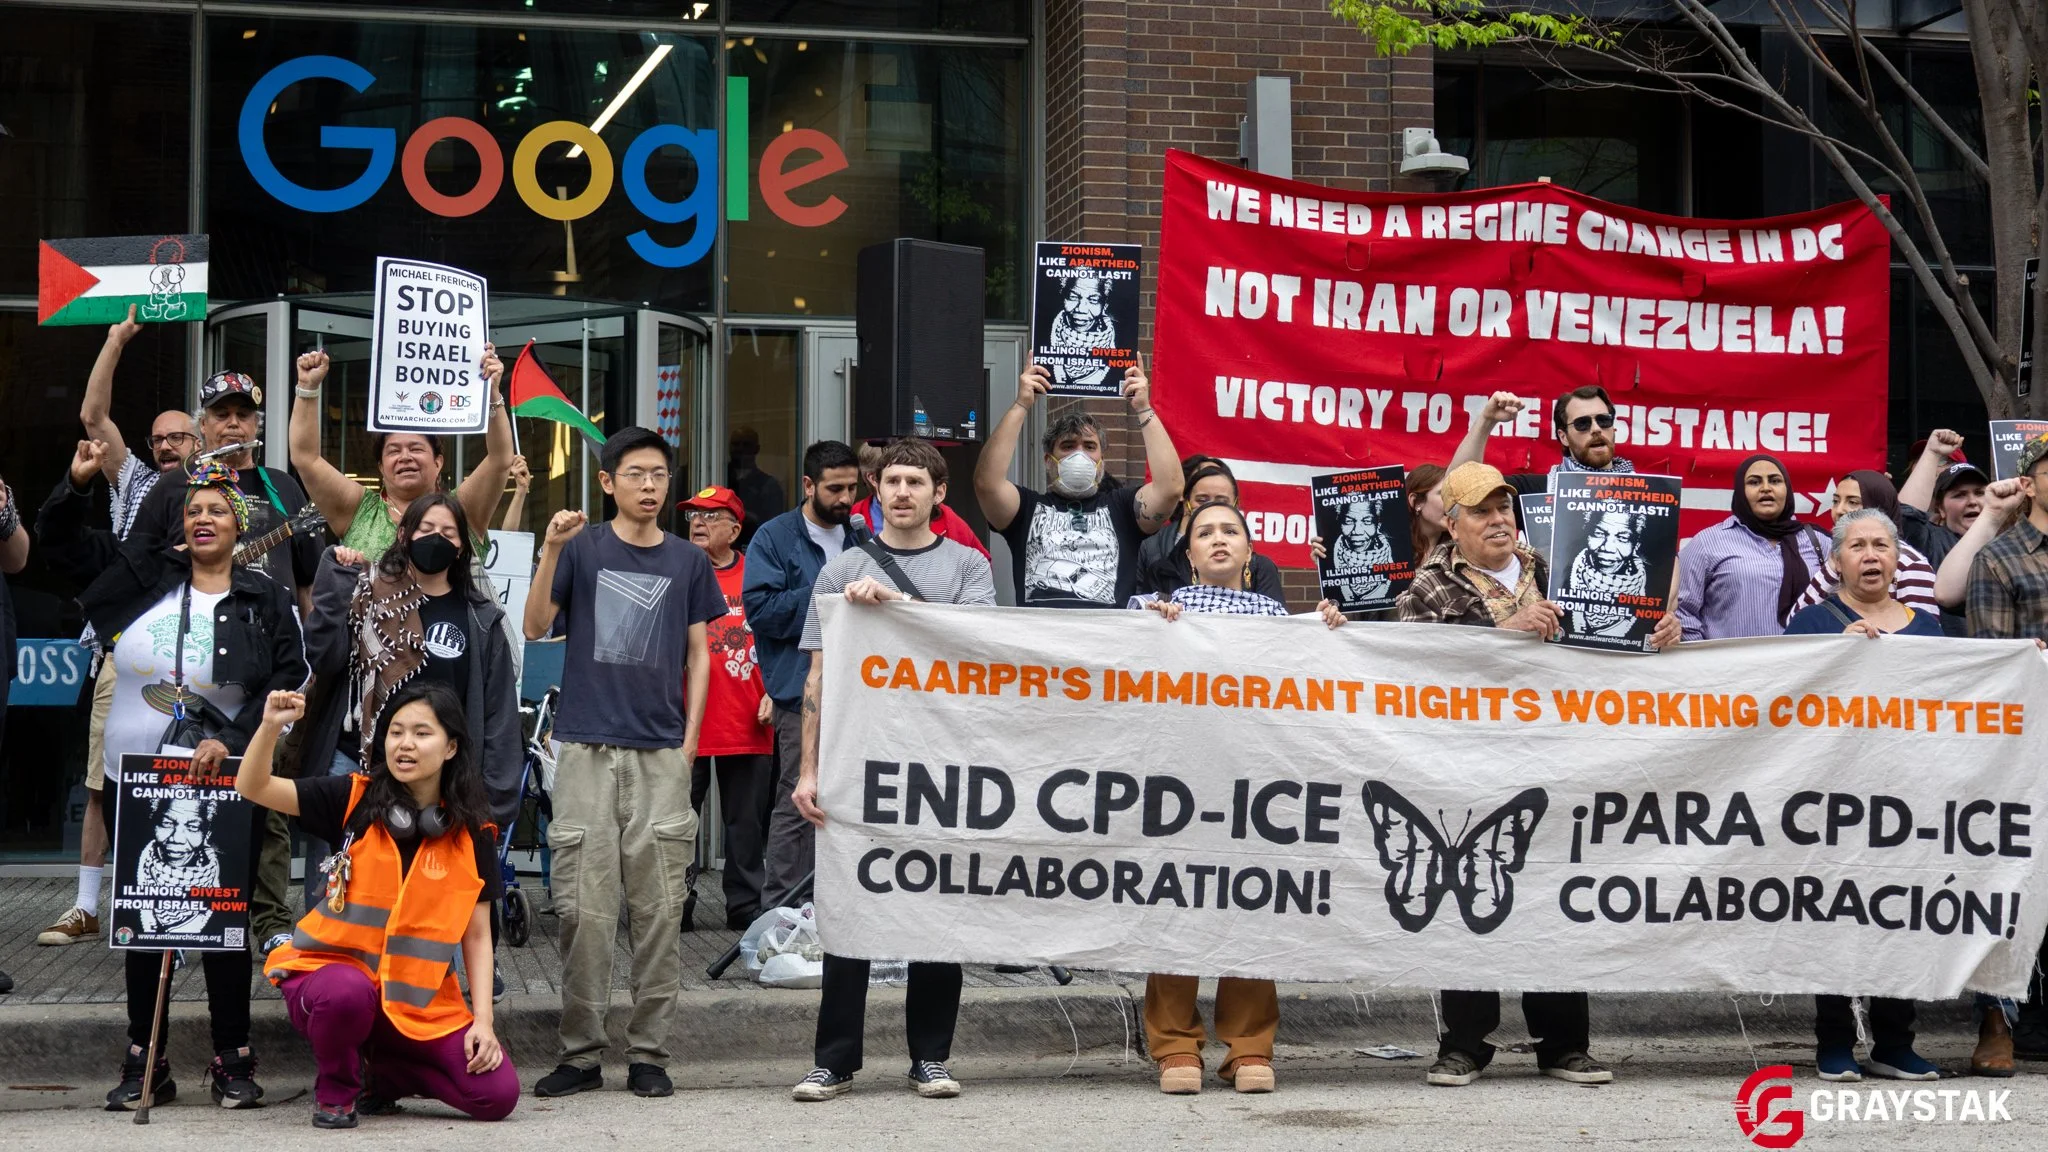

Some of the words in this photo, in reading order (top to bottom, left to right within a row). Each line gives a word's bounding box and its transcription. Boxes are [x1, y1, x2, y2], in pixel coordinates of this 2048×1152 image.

[238, 55, 849, 268] Google
[1206, 180, 1261, 224] WE
[1270, 193, 1372, 236] NEED
[1382, 206, 1411, 239] A
[1421, 201, 1570, 245] REGIME
[1576, 210, 1735, 263] CHANGE
[1739, 228, 1784, 265] IN
[1794, 223, 1845, 262] DC
[1061, 246, 1114, 258] ZIONISM,
[1039, 257, 1066, 266] LIKE
[1069, 258, 1140, 270] APARTHEID,
[389, 268, 433, 281] MICHAEL
[435, 273, 480, 293] FRERICHS:
[1046, 268, 1096, 279] CANNOT
[1098, 270, 1132, 281] LAST!
[396, 284, 474, 316] STOP
[1205, 266, 1301, 323] NOT
[1312, 278, 1437, 336] IRAN
[1448, 287, 1512, 338] OR
[1525, 290, 1846, 355] VENEZUELA!
[398, 318, 471, 339] BUYING
[397, 341, 472, 363] ISRAEL
[1040, 346, 1090, 357] ILLINOIS,
[1092, 347, 1131, 357] DIVEST
[1033, 356, 1065, 366] FROM
[1067, 357, 1106, 367] ISRAEL
[1108, 359, 1137, 368] NOW!
[396, 365, 470, 387] BONDS
[450, 394, 472, 407] BDS
[1215, 376, 1393, 430] VICTORY
[1402, 392, 1453, 434] TO
[380, 414, 466, 424] ANTIWARCHICAGO.COM
[1995, 433, 2022, 442] LIKE
[1332, 471, 1380, 484] ZIONISM,
[1585, 476, 1649, 490] ZIONISM,
[1314, 486, 1338, 497] LIKE
[1341, 479, 1404, 494] APARTHEID,
[1321, 494, 1366, 507] CANNOT
[1368, 490, 1399, 501] LAST!
[1559, 488, 1591, 498] LIKE
[1594, 489, 1679, 506] APARTHEID,
[1526, 506, 1553, 514] LIKE
[1566, 501, 1626, 513] CANNOT
[1629, 504, 1670, 517] LAST!
[1326, 565, 1371, 577] ILLINOIS,
[1372, 561, 1409, 573] DIVEST
[1322, 576, 1350, 588] FROM
[1352, 573, 1387, 584] ISRAEL
[1388, 571, 1415, 581] NOW!
[1557, 588, 1615, 604] ILLINOIS,
[1618, 594, 1662, 607] DIVEST
[1588, 603, 1632, 617] ISRAEL
[1568, 633, 1642, 646] www.antiwarchicago.org
[861, 654, 1091, 701] CAARPR'S
[1103, 668, 1364, 714] IMMIGRANT
[1375, 683, 1541, 723] RIGHTS
[1552, 689, 1759, 728] WORKING
[1769, 693, 2024, 735] COMMITTEE
[123, 772, 159, 784] LIKE
[132, 787, 196, 800] CANNOT
[200, 790, 241, 802] LAST!
[862, 760, 1016, 830] END
[1036, 768, 1343, 845] CPD-ICE
[1569, 791, 1765, 864] ¡PARA
[1781, 790, 2032, 858] CPD-ICE
[857, 847, 1332, 917] COLLABORATION!
[123, 885, 187, 899] ILLINOIS,
[190, 887, 241, 898] DIVEST
[115, 899, 154, 910] FROM
[158, 900, 208, 911] ISRAEL
[211, 902, 248, 912] NOW!
[1559, 873, 2021, 940] COLABORACIÓN!
[137, 933, 222, 943] www.antiwarchicago.org
